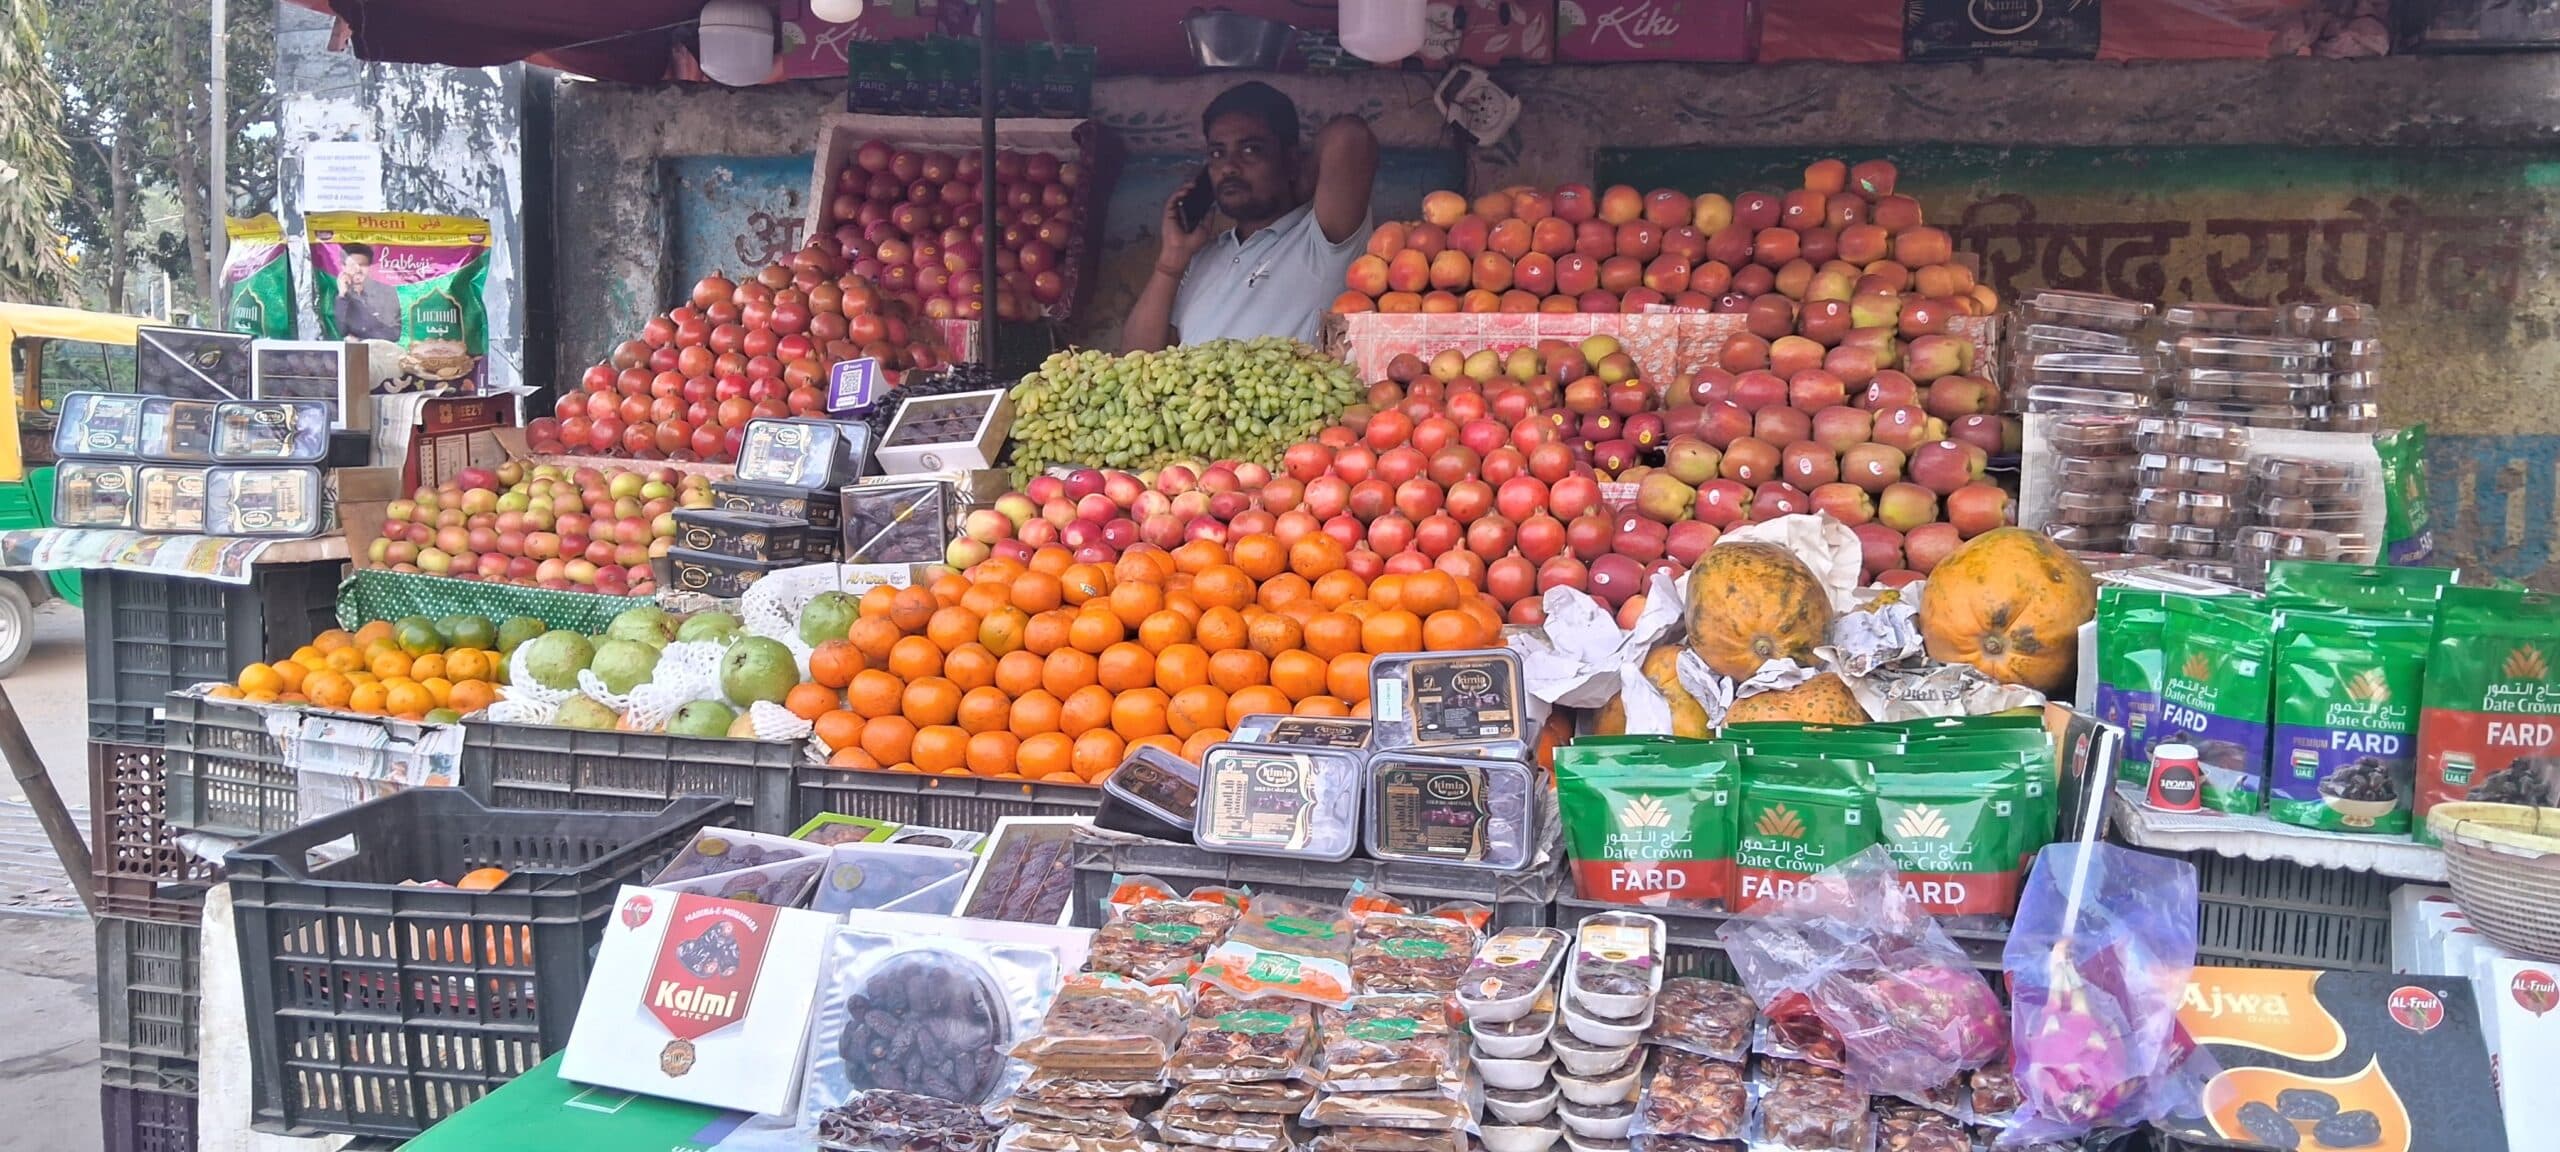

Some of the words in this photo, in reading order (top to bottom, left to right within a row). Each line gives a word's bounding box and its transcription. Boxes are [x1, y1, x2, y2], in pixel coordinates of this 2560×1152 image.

[358, 216, 406, 229] Pheni
[2165, 688, 2186, 701] Date
[2186, 692, 2216, 711] Crown
[2483, 696, 2515, 711] Date
[2518, 698, 2560, 713] Crown
[2163, 703, 2208, 733] FARD
[2326, 712, 2359, 726] Date
[2363, 715, 2405, 731] Crown
[2331, 731, 2399, 754] FARD
[2487, 722, 2553, 746] FARD
[2295, 768, 2313, 778] UAE
[2445, 773, 2467, 784] UAE
[1603, 846, 1638, 859] Date
[1641, 846, 1692, 859] Crown
[1736, 852, 1771, 868] Date
[1774, 856, 1824, 873] Crown
[1918, 857, 1973, 871] Crown
[1611, 868, 1687, 891] FARD
[1742, 875, 1817, 903] FARD
[654, 980, 738, 1018] Kalmi
[2176, 982, 2289, 1018] Ajwa
[672, 1010, 709, 1021] DATES
